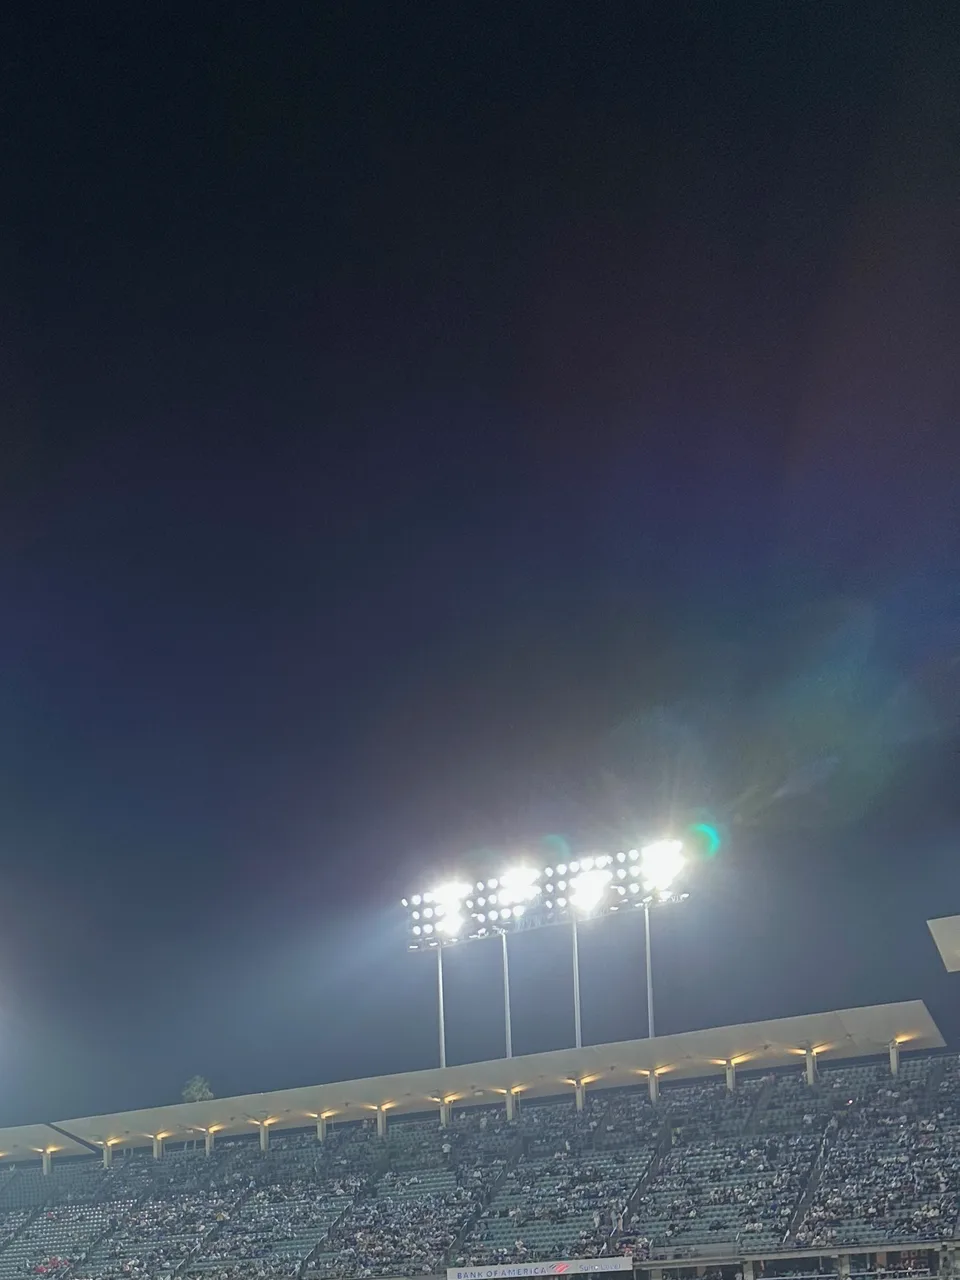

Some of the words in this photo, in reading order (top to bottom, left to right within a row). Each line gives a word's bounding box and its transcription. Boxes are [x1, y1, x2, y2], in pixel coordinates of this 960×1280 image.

[457, 1271, 483, 1280] BANK
[486, 1270, 498, 1278] OF
[499, 1267, 547, 1276] AMERICA
